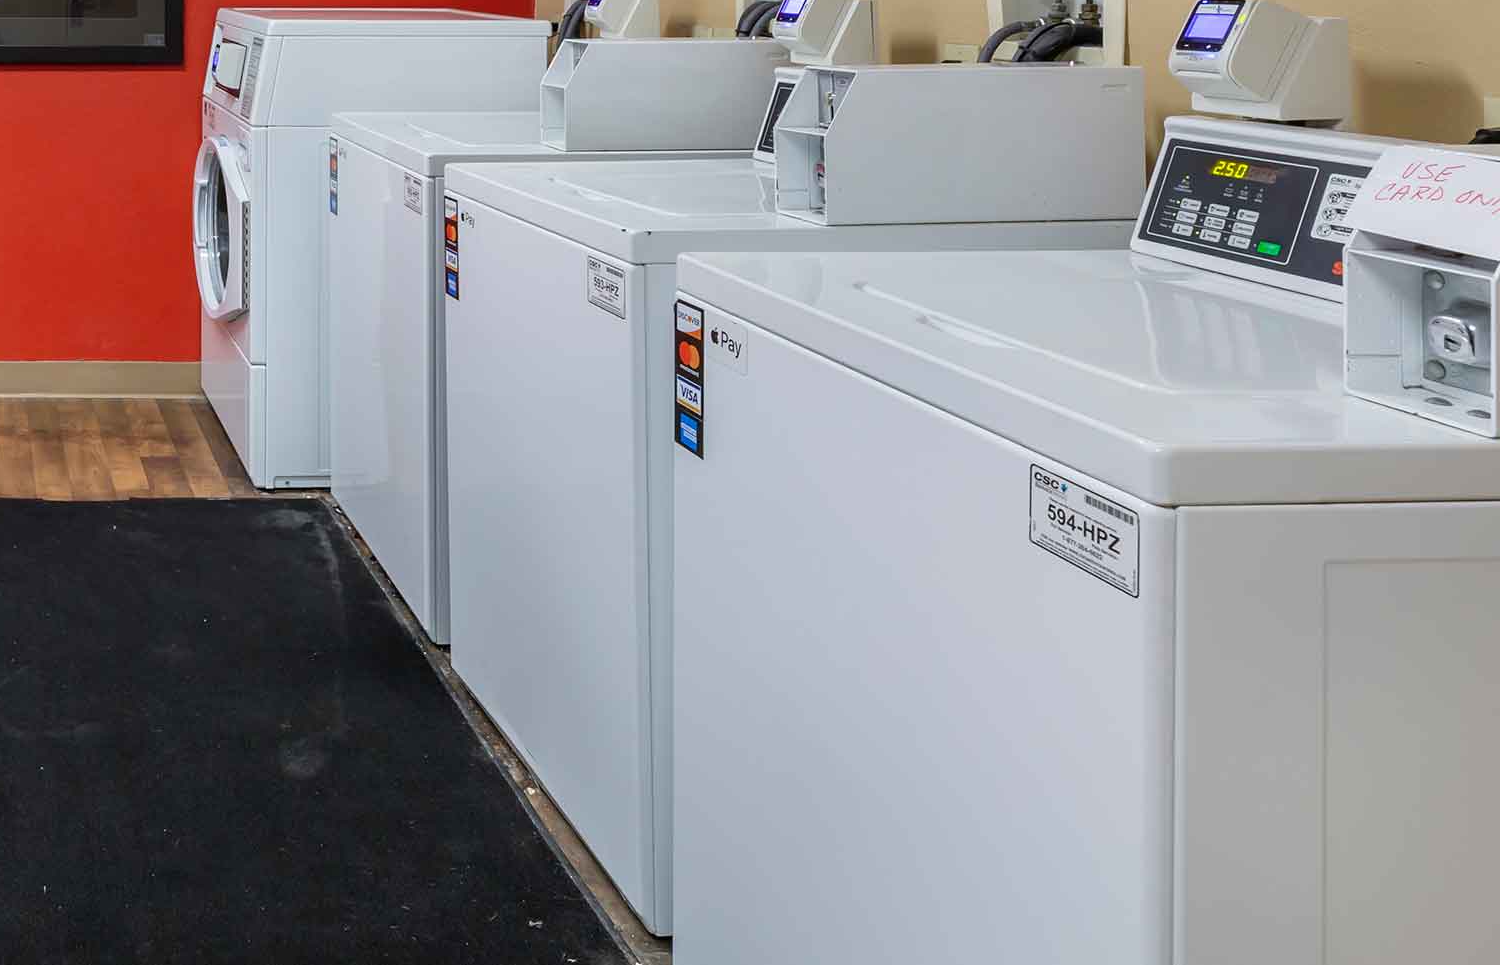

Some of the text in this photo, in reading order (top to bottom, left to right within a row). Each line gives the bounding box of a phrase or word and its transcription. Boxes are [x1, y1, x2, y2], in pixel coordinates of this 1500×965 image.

[1402, 162, 1466, 182] USE
[1374, 182, 1445, 201] CARD
[720, 330, 742, 359] Pay
[680, 383, 699, 405] VISA
[1034, 471, 1060, 490] CSC
[1047, 503, 1121, 555] 594-HPZ
